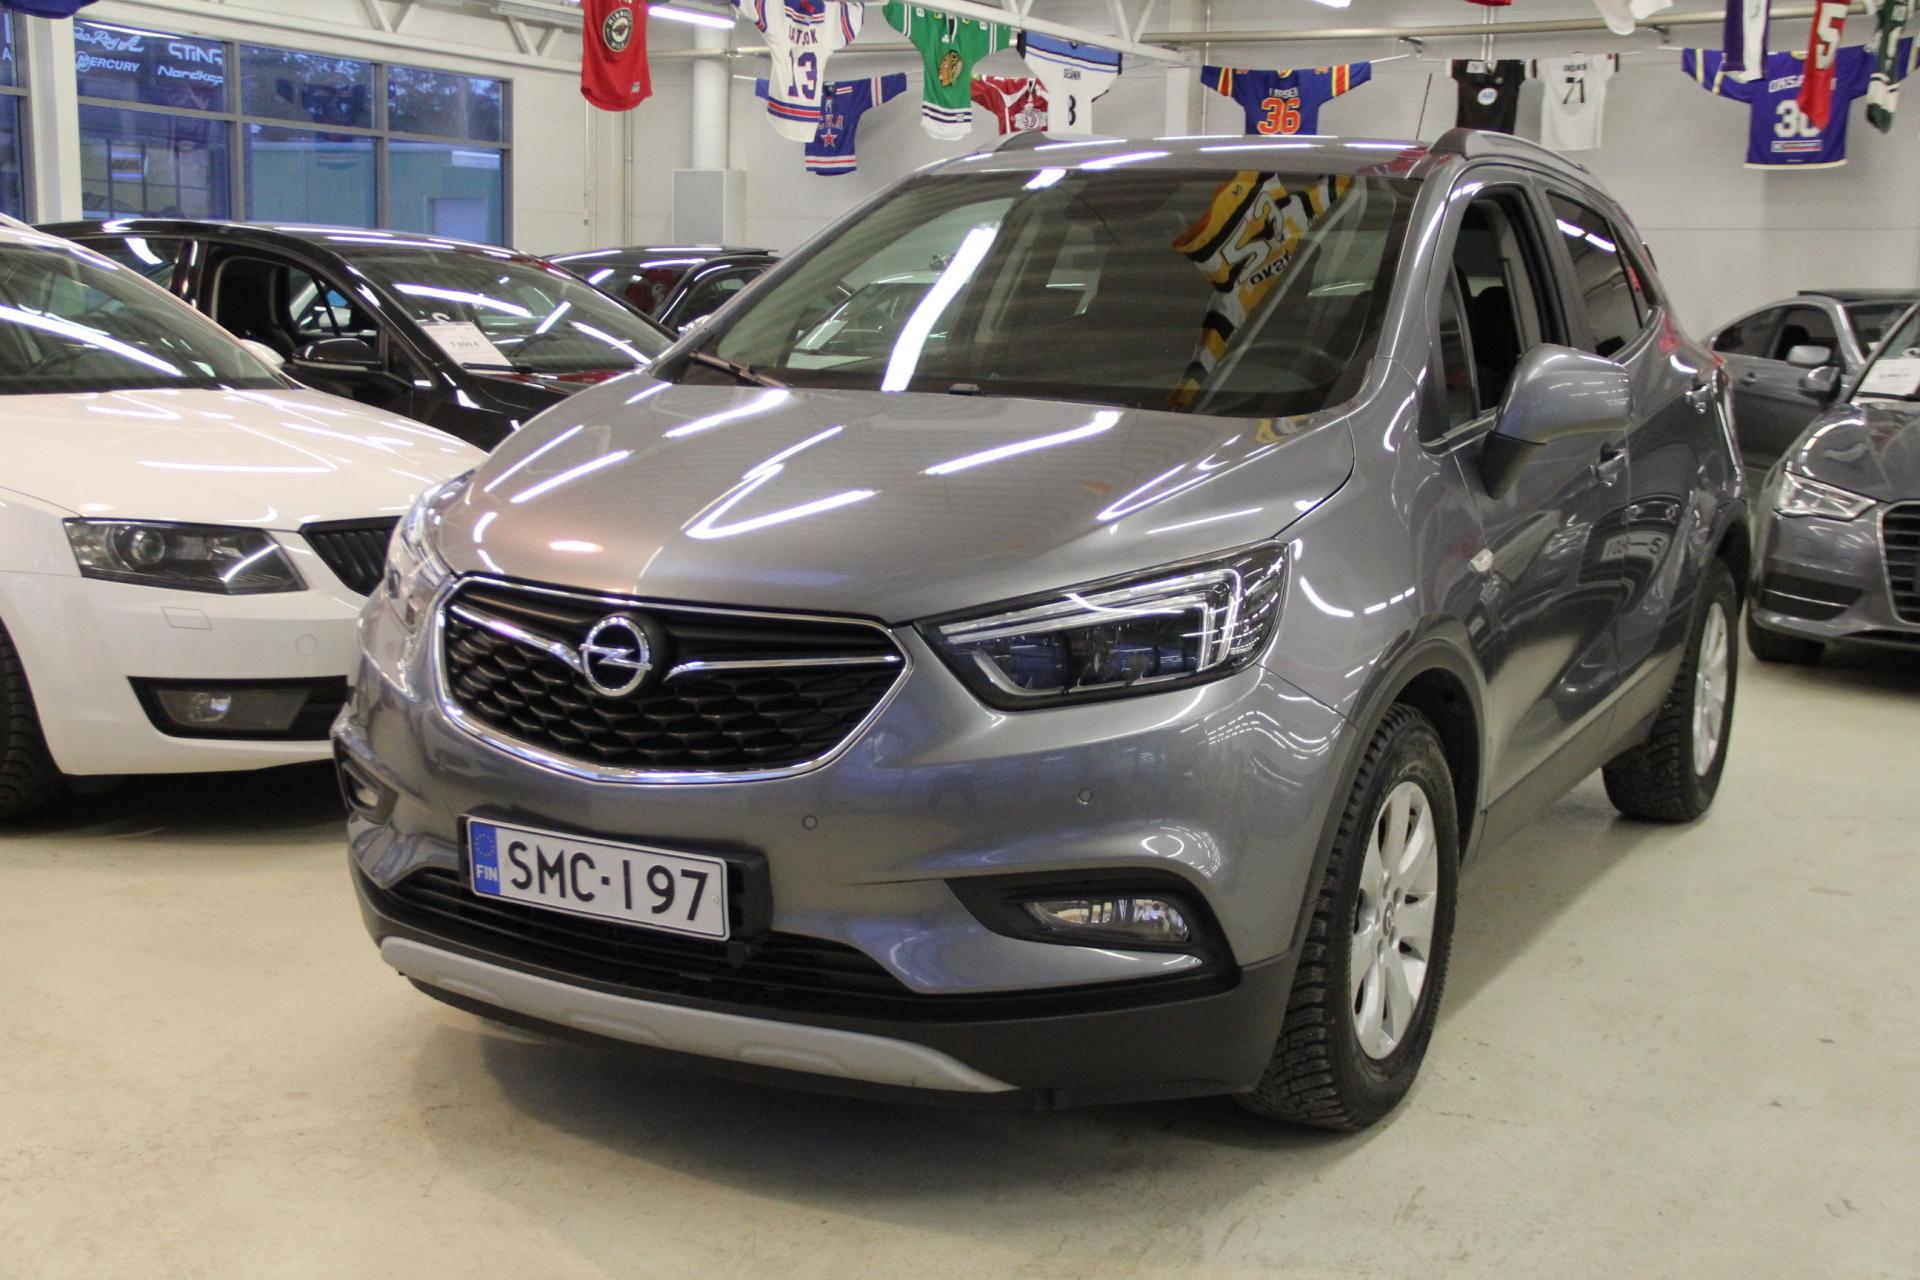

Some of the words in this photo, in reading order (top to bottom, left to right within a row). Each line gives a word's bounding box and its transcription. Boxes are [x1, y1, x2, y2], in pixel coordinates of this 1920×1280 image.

[76, 54, 140, 72] MERCURY
[788, 48, 818, 100] 13
[1563, 76, 1585, 104] 71
[1257, 97, 1301, 135] 36
[476, 864, 498, 881] FIN
[508, 841, 708, 921] SMC-197
